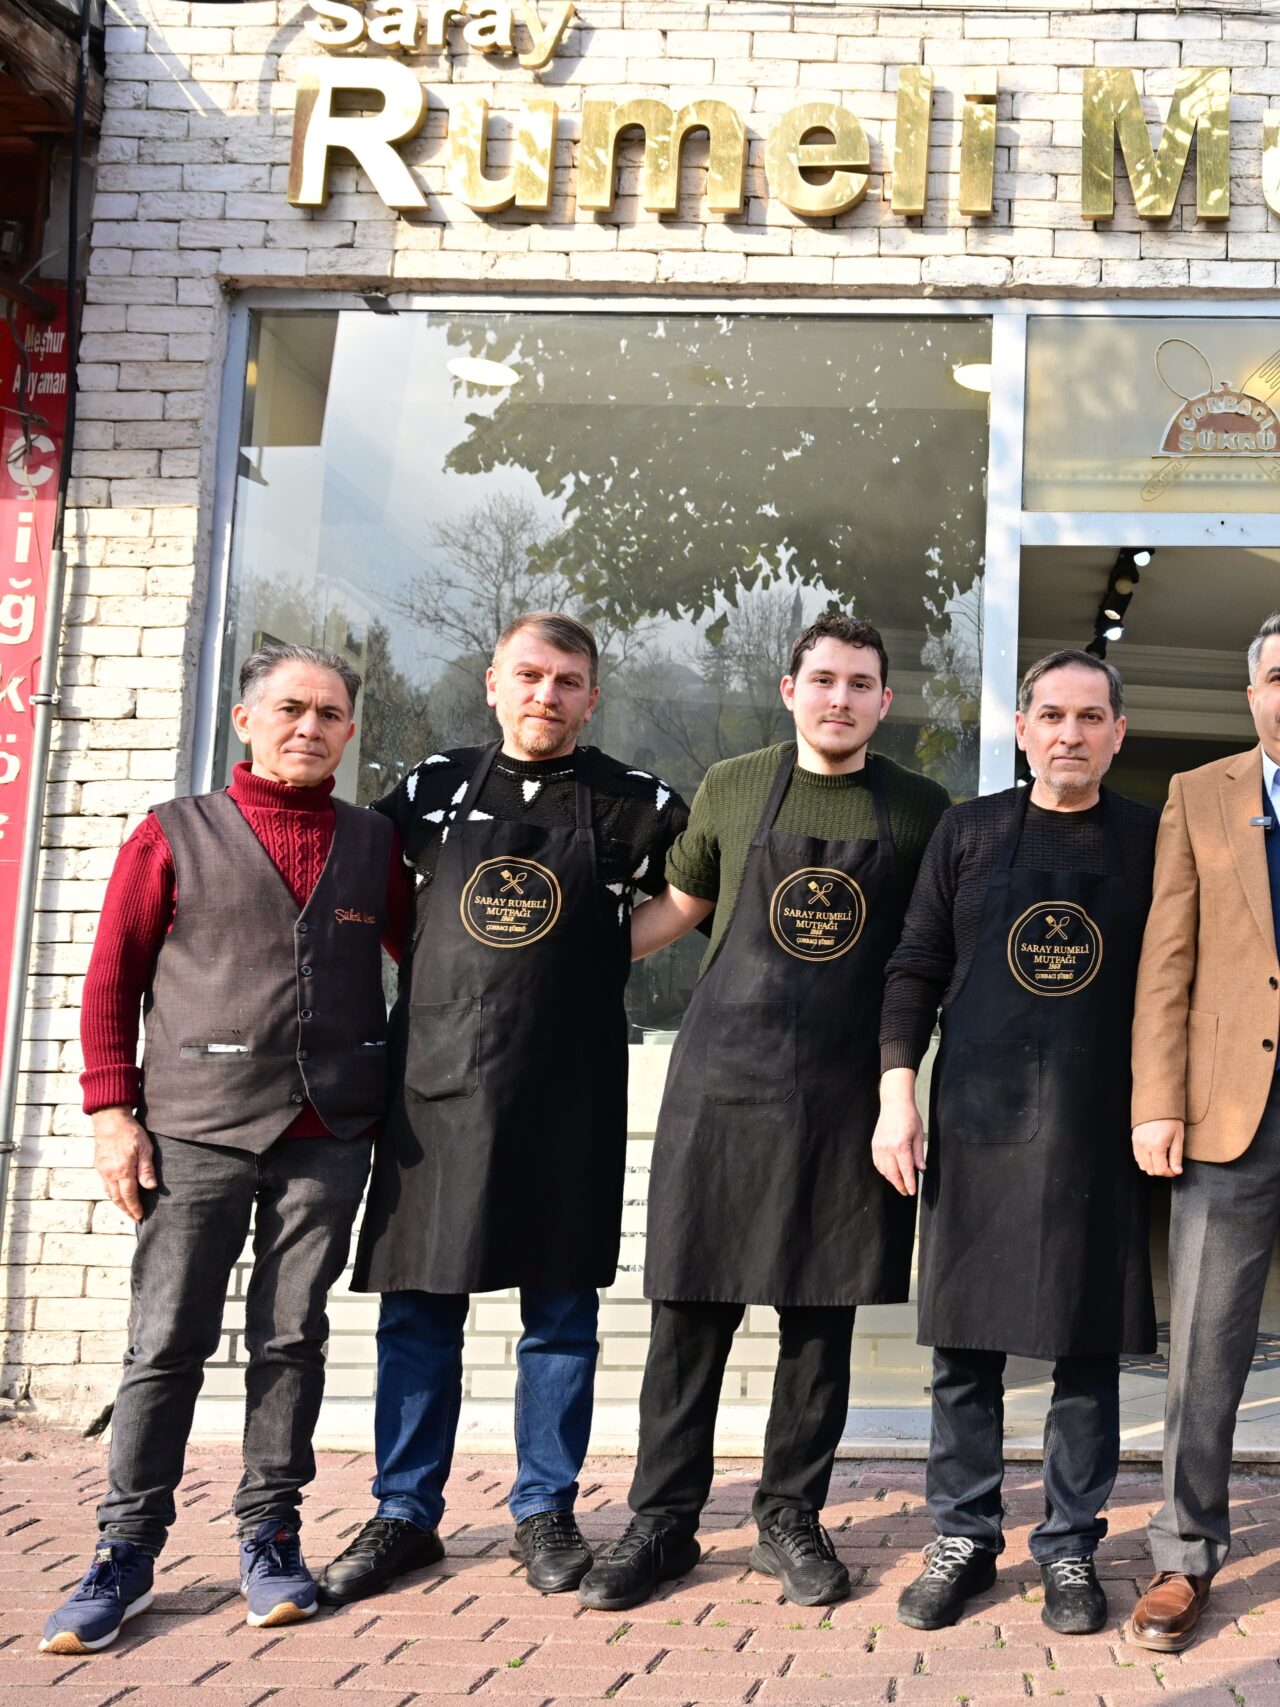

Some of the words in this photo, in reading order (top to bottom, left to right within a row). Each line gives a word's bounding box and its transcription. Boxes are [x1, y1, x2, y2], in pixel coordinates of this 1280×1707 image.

[302, 0, 577, 70] Saray
[287, 56, 999, 218] Rumeli
[25, 324, 66, 361] Meşhur
[12, 364, 68, 402] Aıyaman
[474, 895, 507, 907] SARAY
[507, 898, 547, 909] RUMELİ
[486, 906, 531, 918] MUTFAĞI
[784, 908, 815, 919] SARAY
[815, 910, 852, 921] RUMELİ
[795, 919, 839, 930] MUTFAĞI
[1021, 943, 1053, 954] SARAY
[1053, 943, 1090, 954] RUMELİ
[1033, 954, 1077, 965] MUTFAĞI
